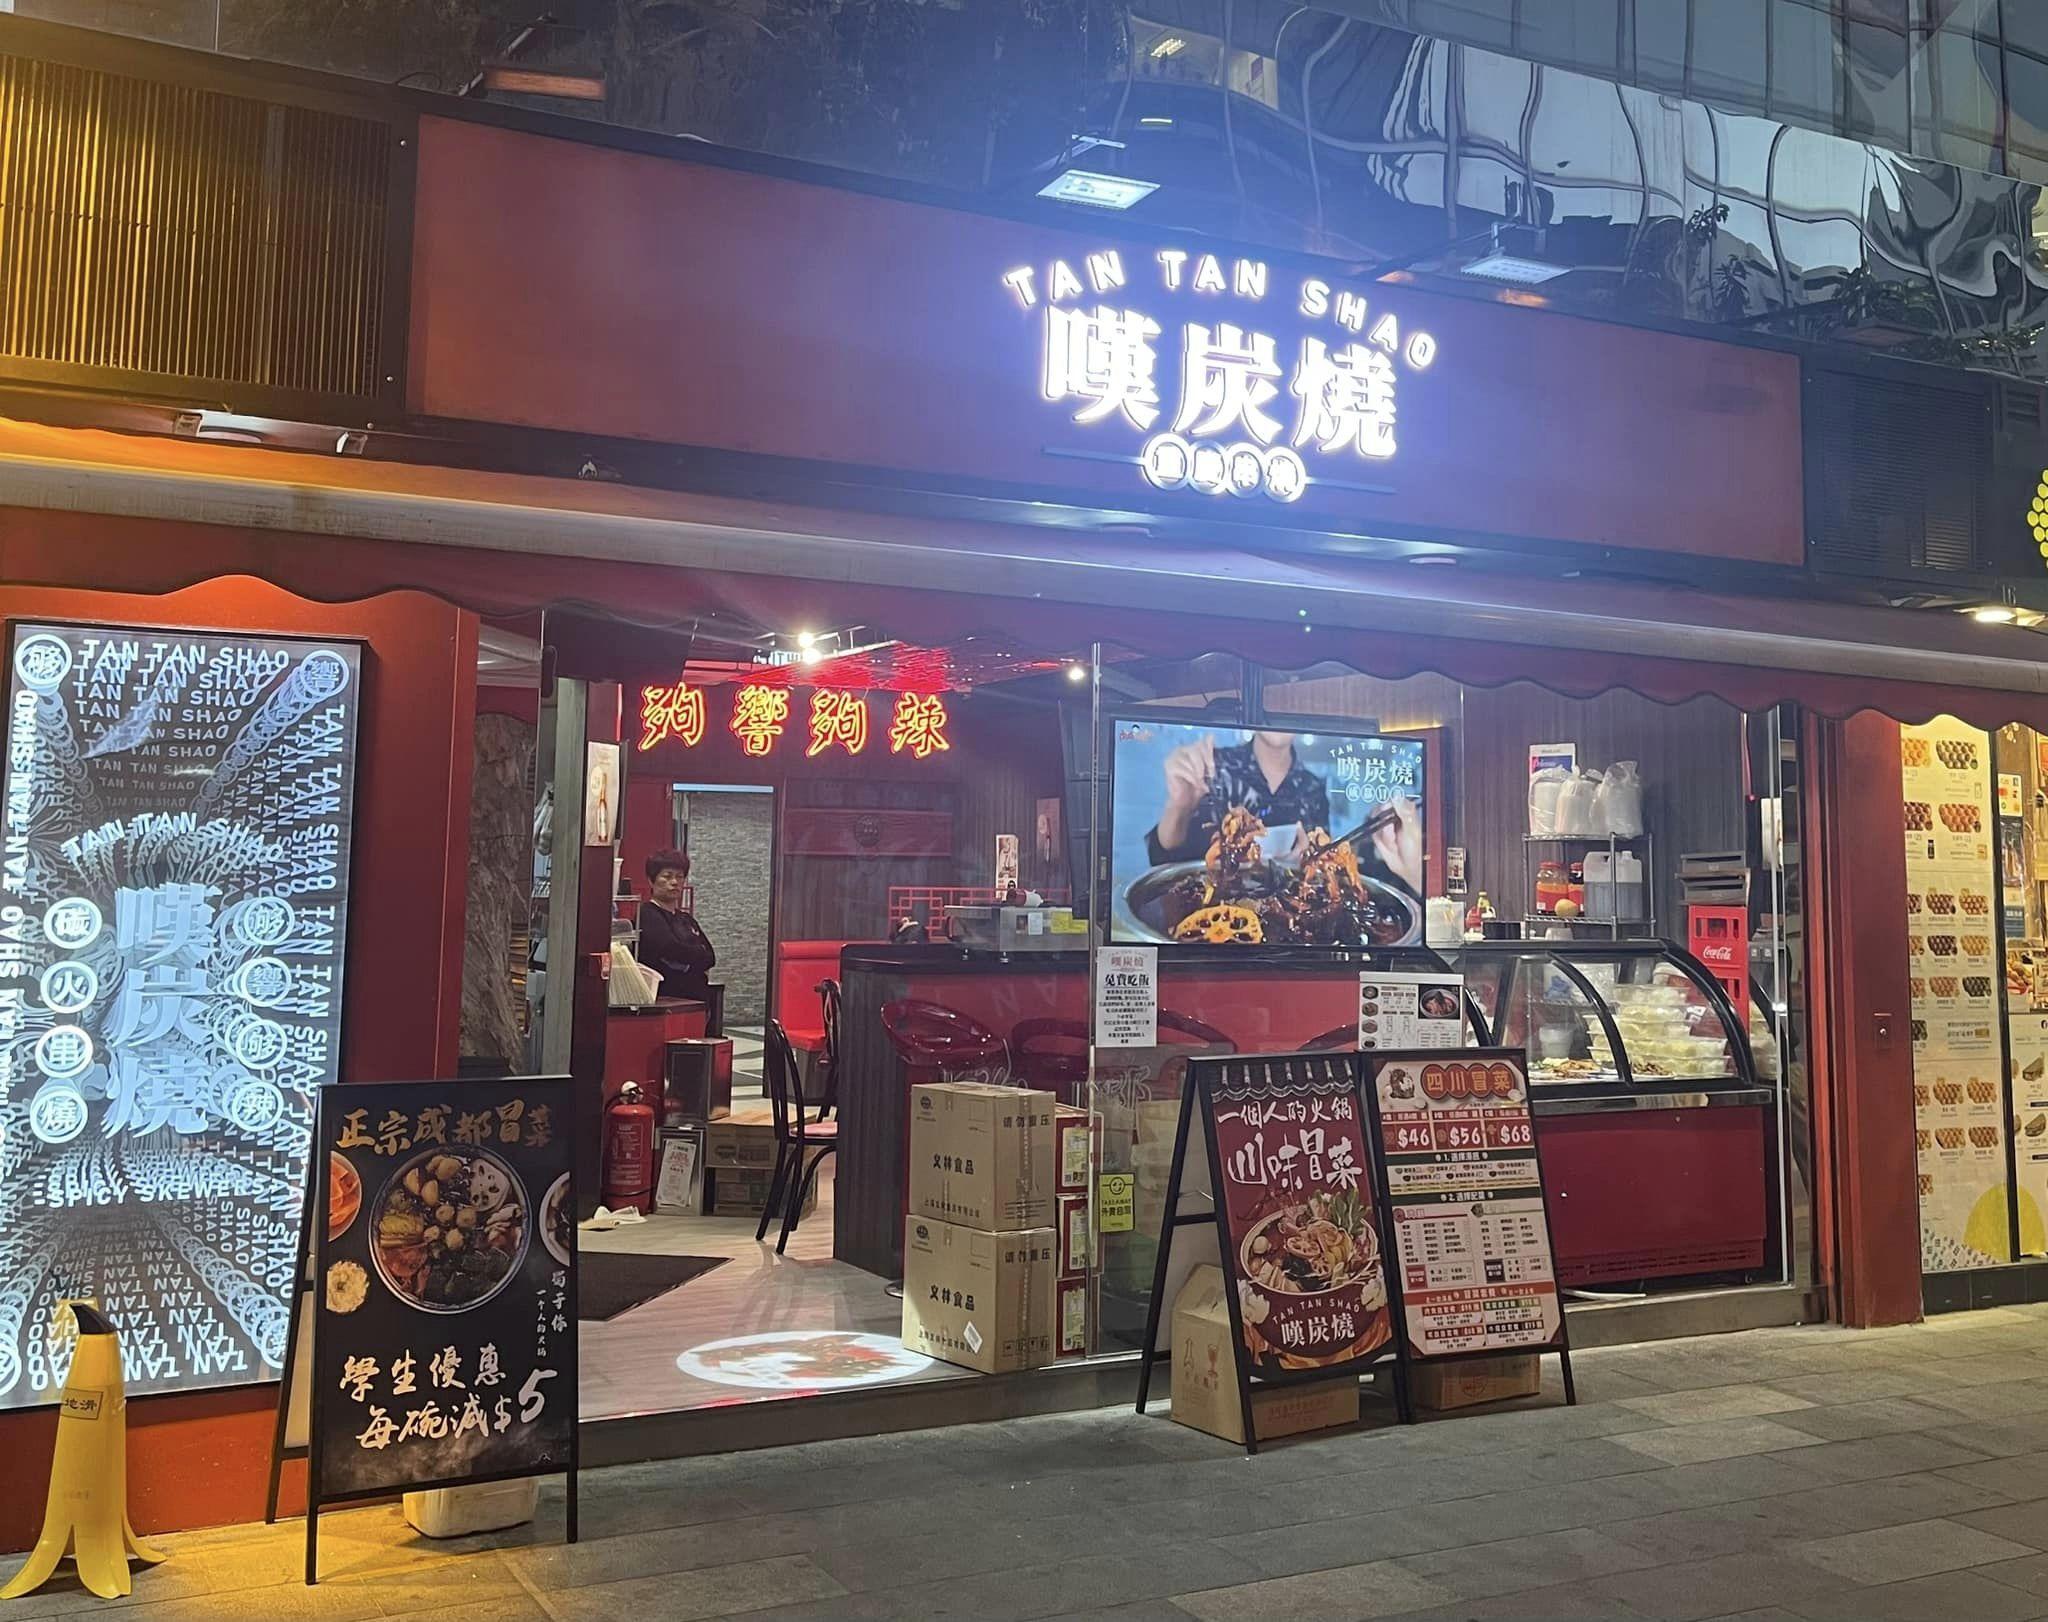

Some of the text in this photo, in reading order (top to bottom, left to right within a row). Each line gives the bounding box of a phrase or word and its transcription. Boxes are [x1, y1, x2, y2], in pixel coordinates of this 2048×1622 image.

[1003, 250, 1437, 368] TAN TAN SHAO
[84, 639, 290, 668] TAN TAN SHAO
[73, 682, 122, 700] TAN
[134, 685, 179, 704] TAN
[76, 701, 120, 719] TAN
[182, 709, 242, 723] SHAO
[173, 724, 229, 740] SHAO
[168, 744, 217, 758] SHAO
[1330, 744, 1353, 758] TAN
[1426, 1070, 1511, 1092] 四川冒菜
[1217, 1096, 1353, 1129] 一個人的火鍋
[1398, 1125, 1531, 1148] $46 $56 $68
[48, 1184, 129, 1208] SPICY
[220, 1201, 234, 1253] SHAO
[235, 1208, 251, 1265] SHAO
[250, 1214, 267, 1276] SHAO
[147, 1263, 184, 1276] TAN
[103, 1280, 143, 1294] TAN
[154, 1277, 195, 1290] TAN
[105, 1292, 206, 1311] TAN TAN
[1273, 1298, 1360, 1325] TAN TAN SHAO
[169, 1307, 217, 1325] TAN
[194, 1350, 248, 1376] TAN
[339, 1342, 506, 1402] 學生優惠
